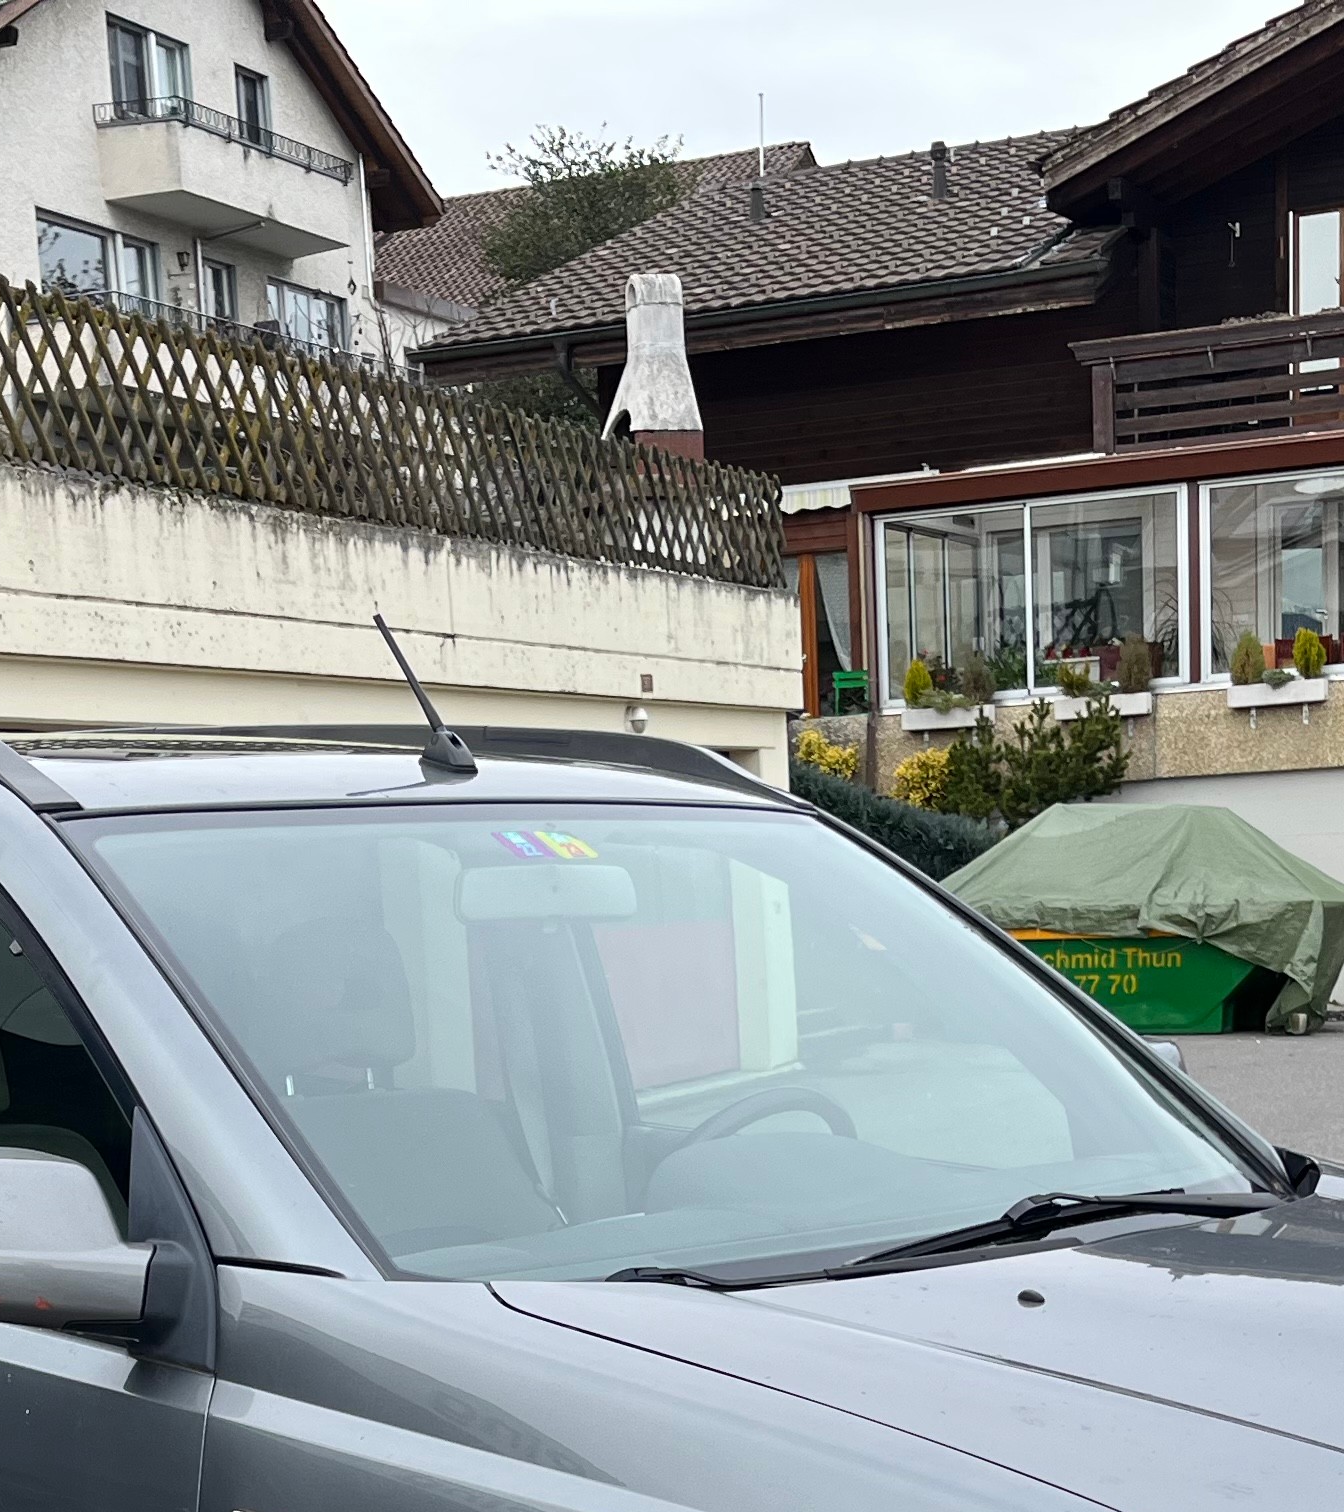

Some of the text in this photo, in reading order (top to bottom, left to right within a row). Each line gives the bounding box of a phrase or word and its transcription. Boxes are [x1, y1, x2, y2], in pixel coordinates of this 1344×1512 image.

[1043, 947, 1182, 969] chmid Thun
[1108, 974, 1137, 996] 70
